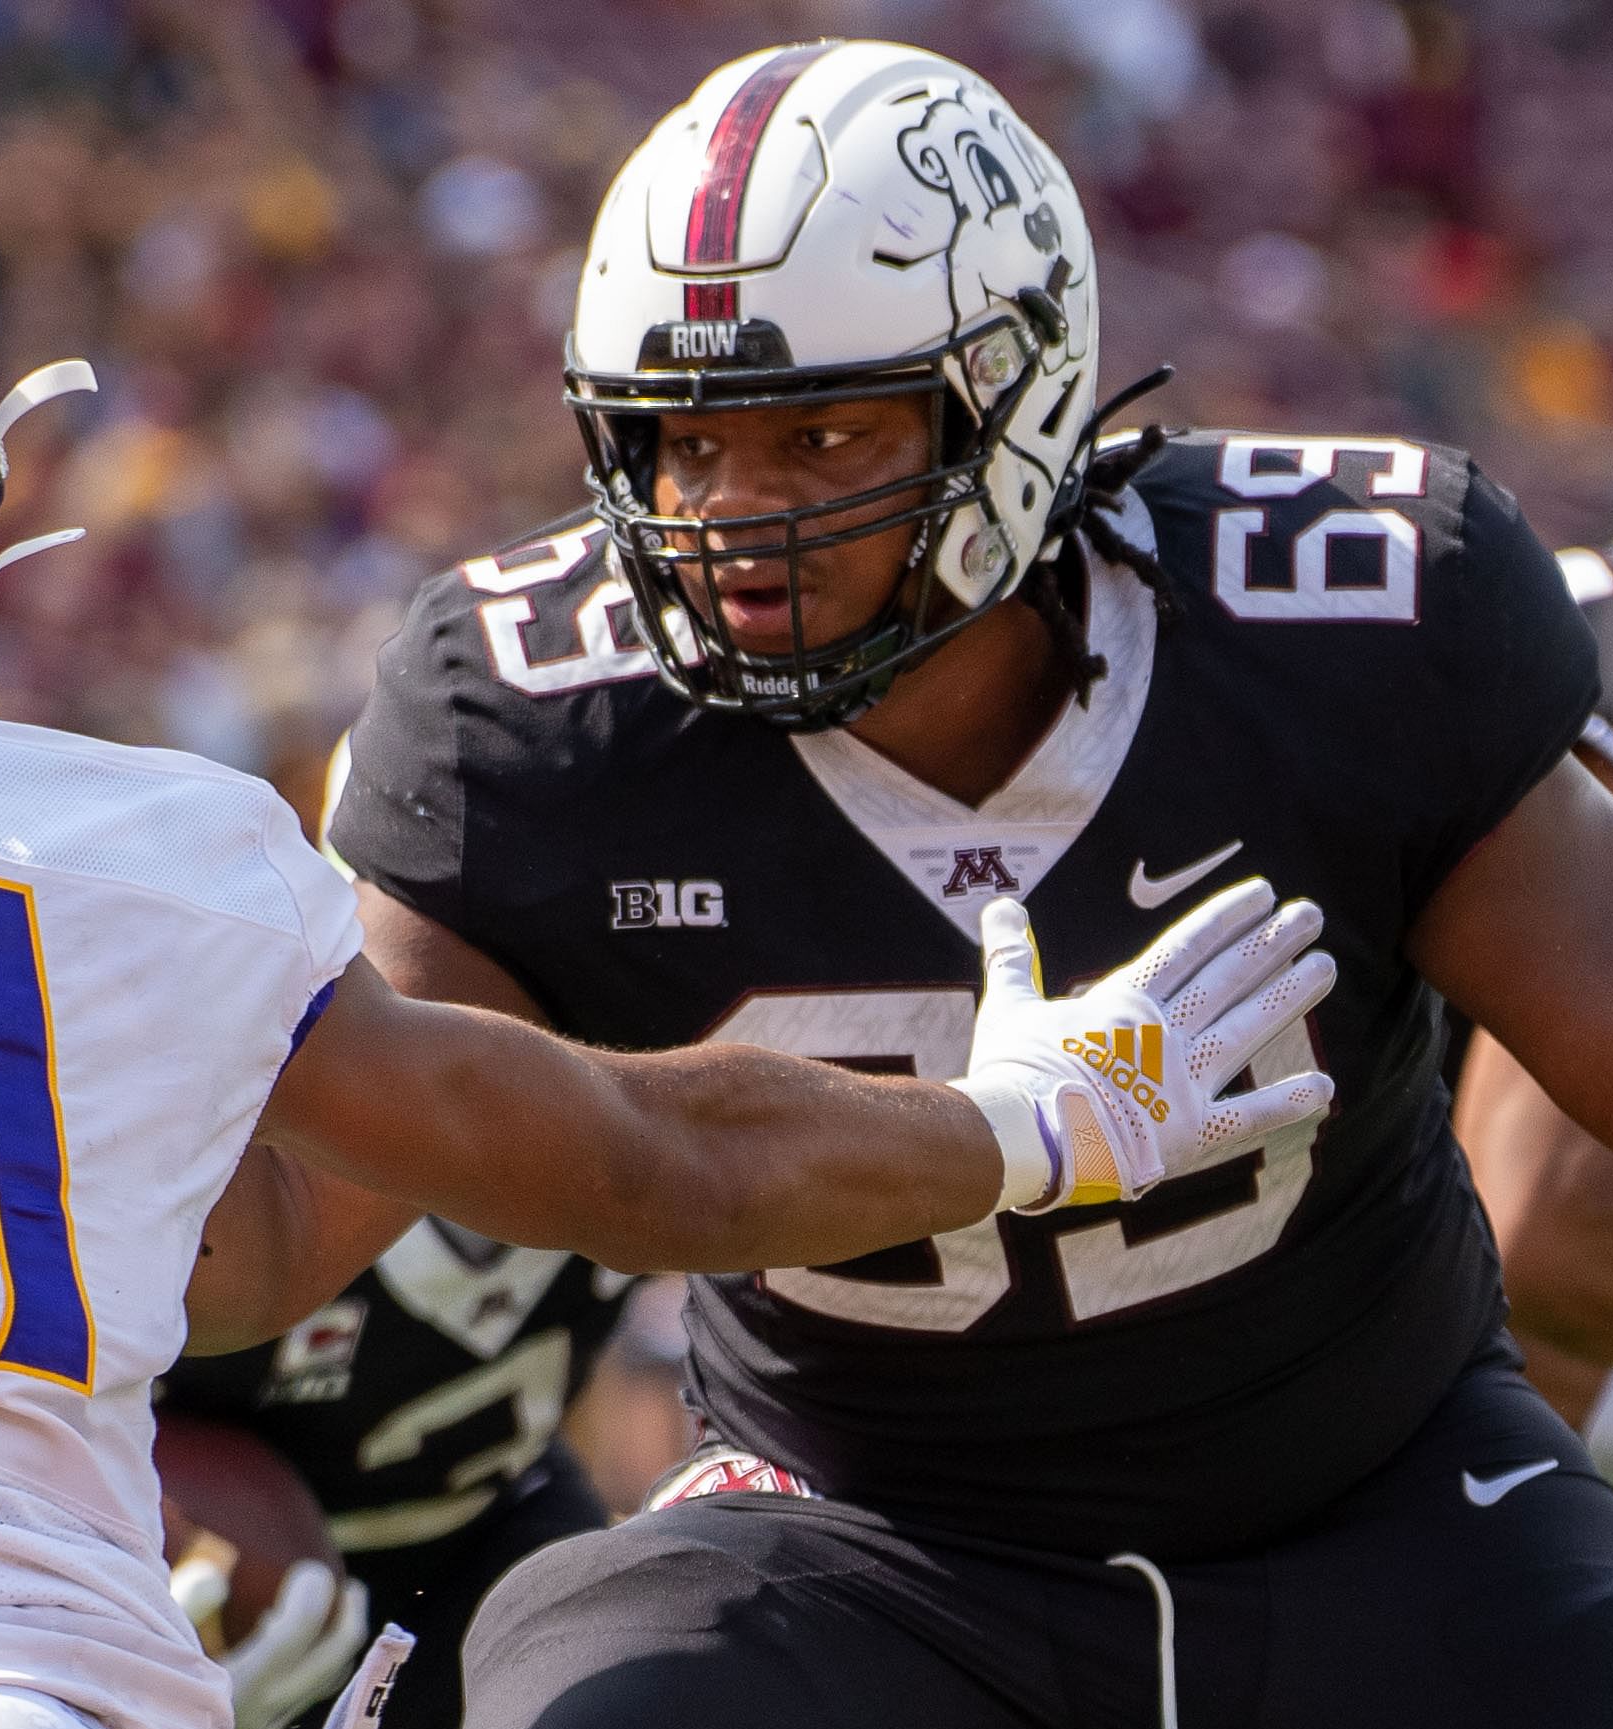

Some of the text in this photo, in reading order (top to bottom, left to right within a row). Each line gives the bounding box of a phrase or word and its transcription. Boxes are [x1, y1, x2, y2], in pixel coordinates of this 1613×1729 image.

[672, 324, 738, 359] ROW
[1212, 434, 1430, 622] 69
[742, 672, 819, 696] Riddell
[943, 846, 1020, 897] M
[1062, 1038, 1170, 1123] adidas
